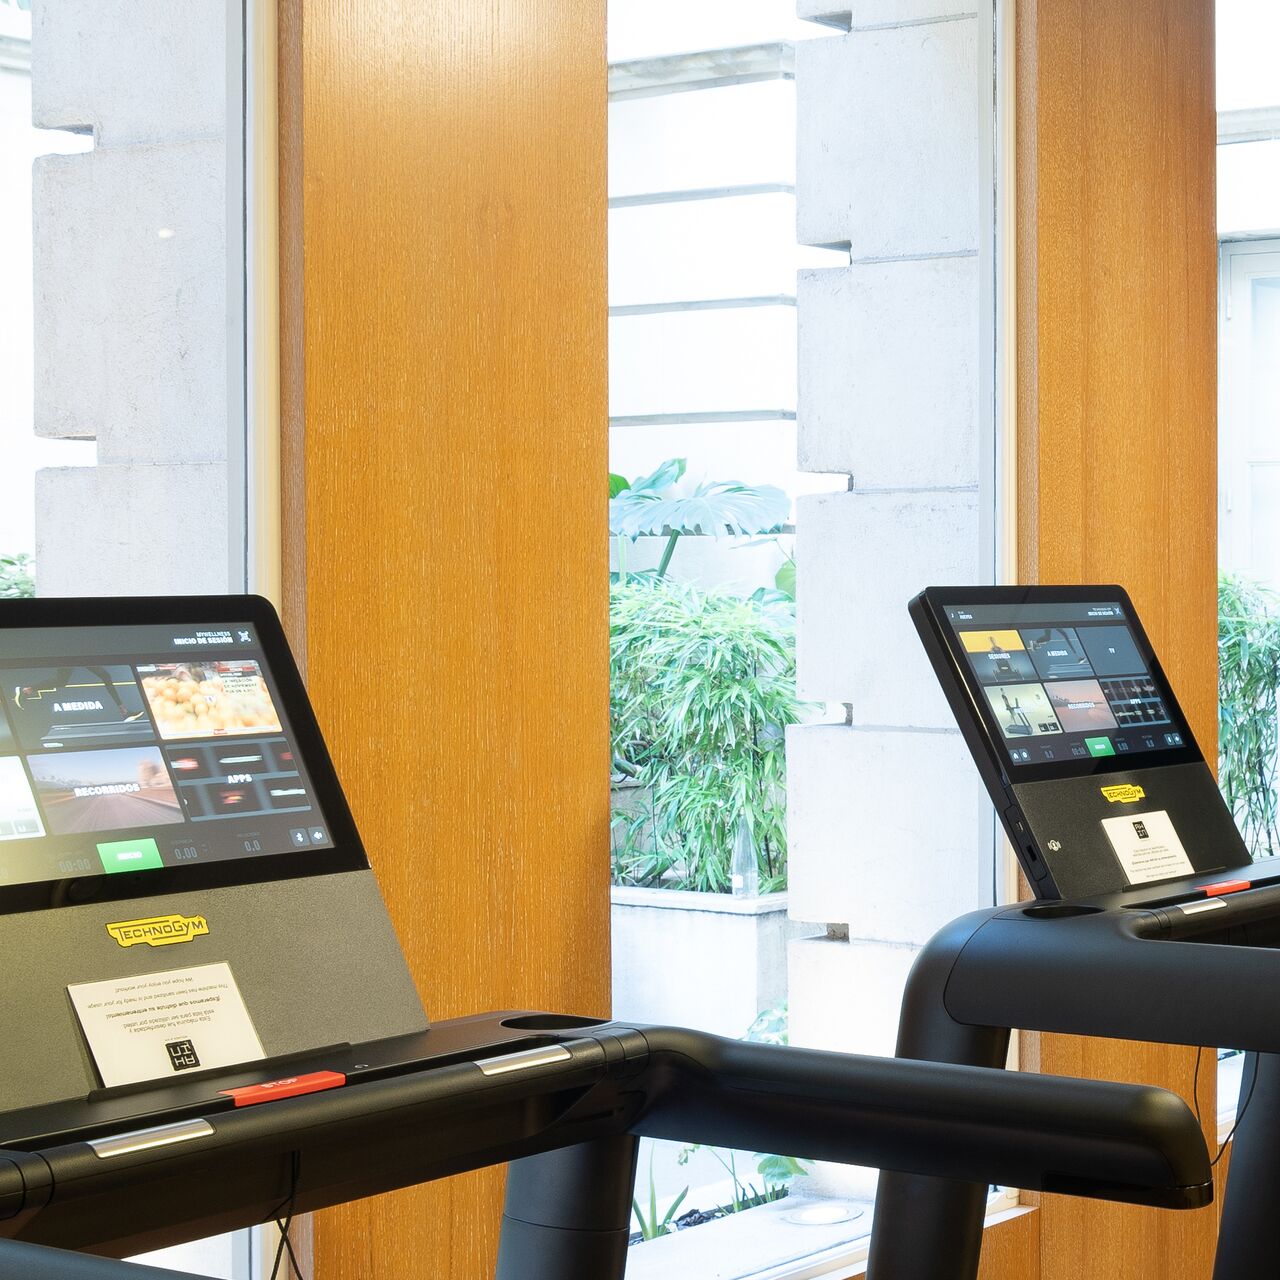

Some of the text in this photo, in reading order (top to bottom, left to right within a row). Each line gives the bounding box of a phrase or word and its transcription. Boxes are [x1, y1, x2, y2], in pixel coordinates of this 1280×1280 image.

[53, 701, 103, 712] A MEDIDA
[228, 774, 252, 784] APPS
[74, 783, 140, 797] RECORRIDOS
